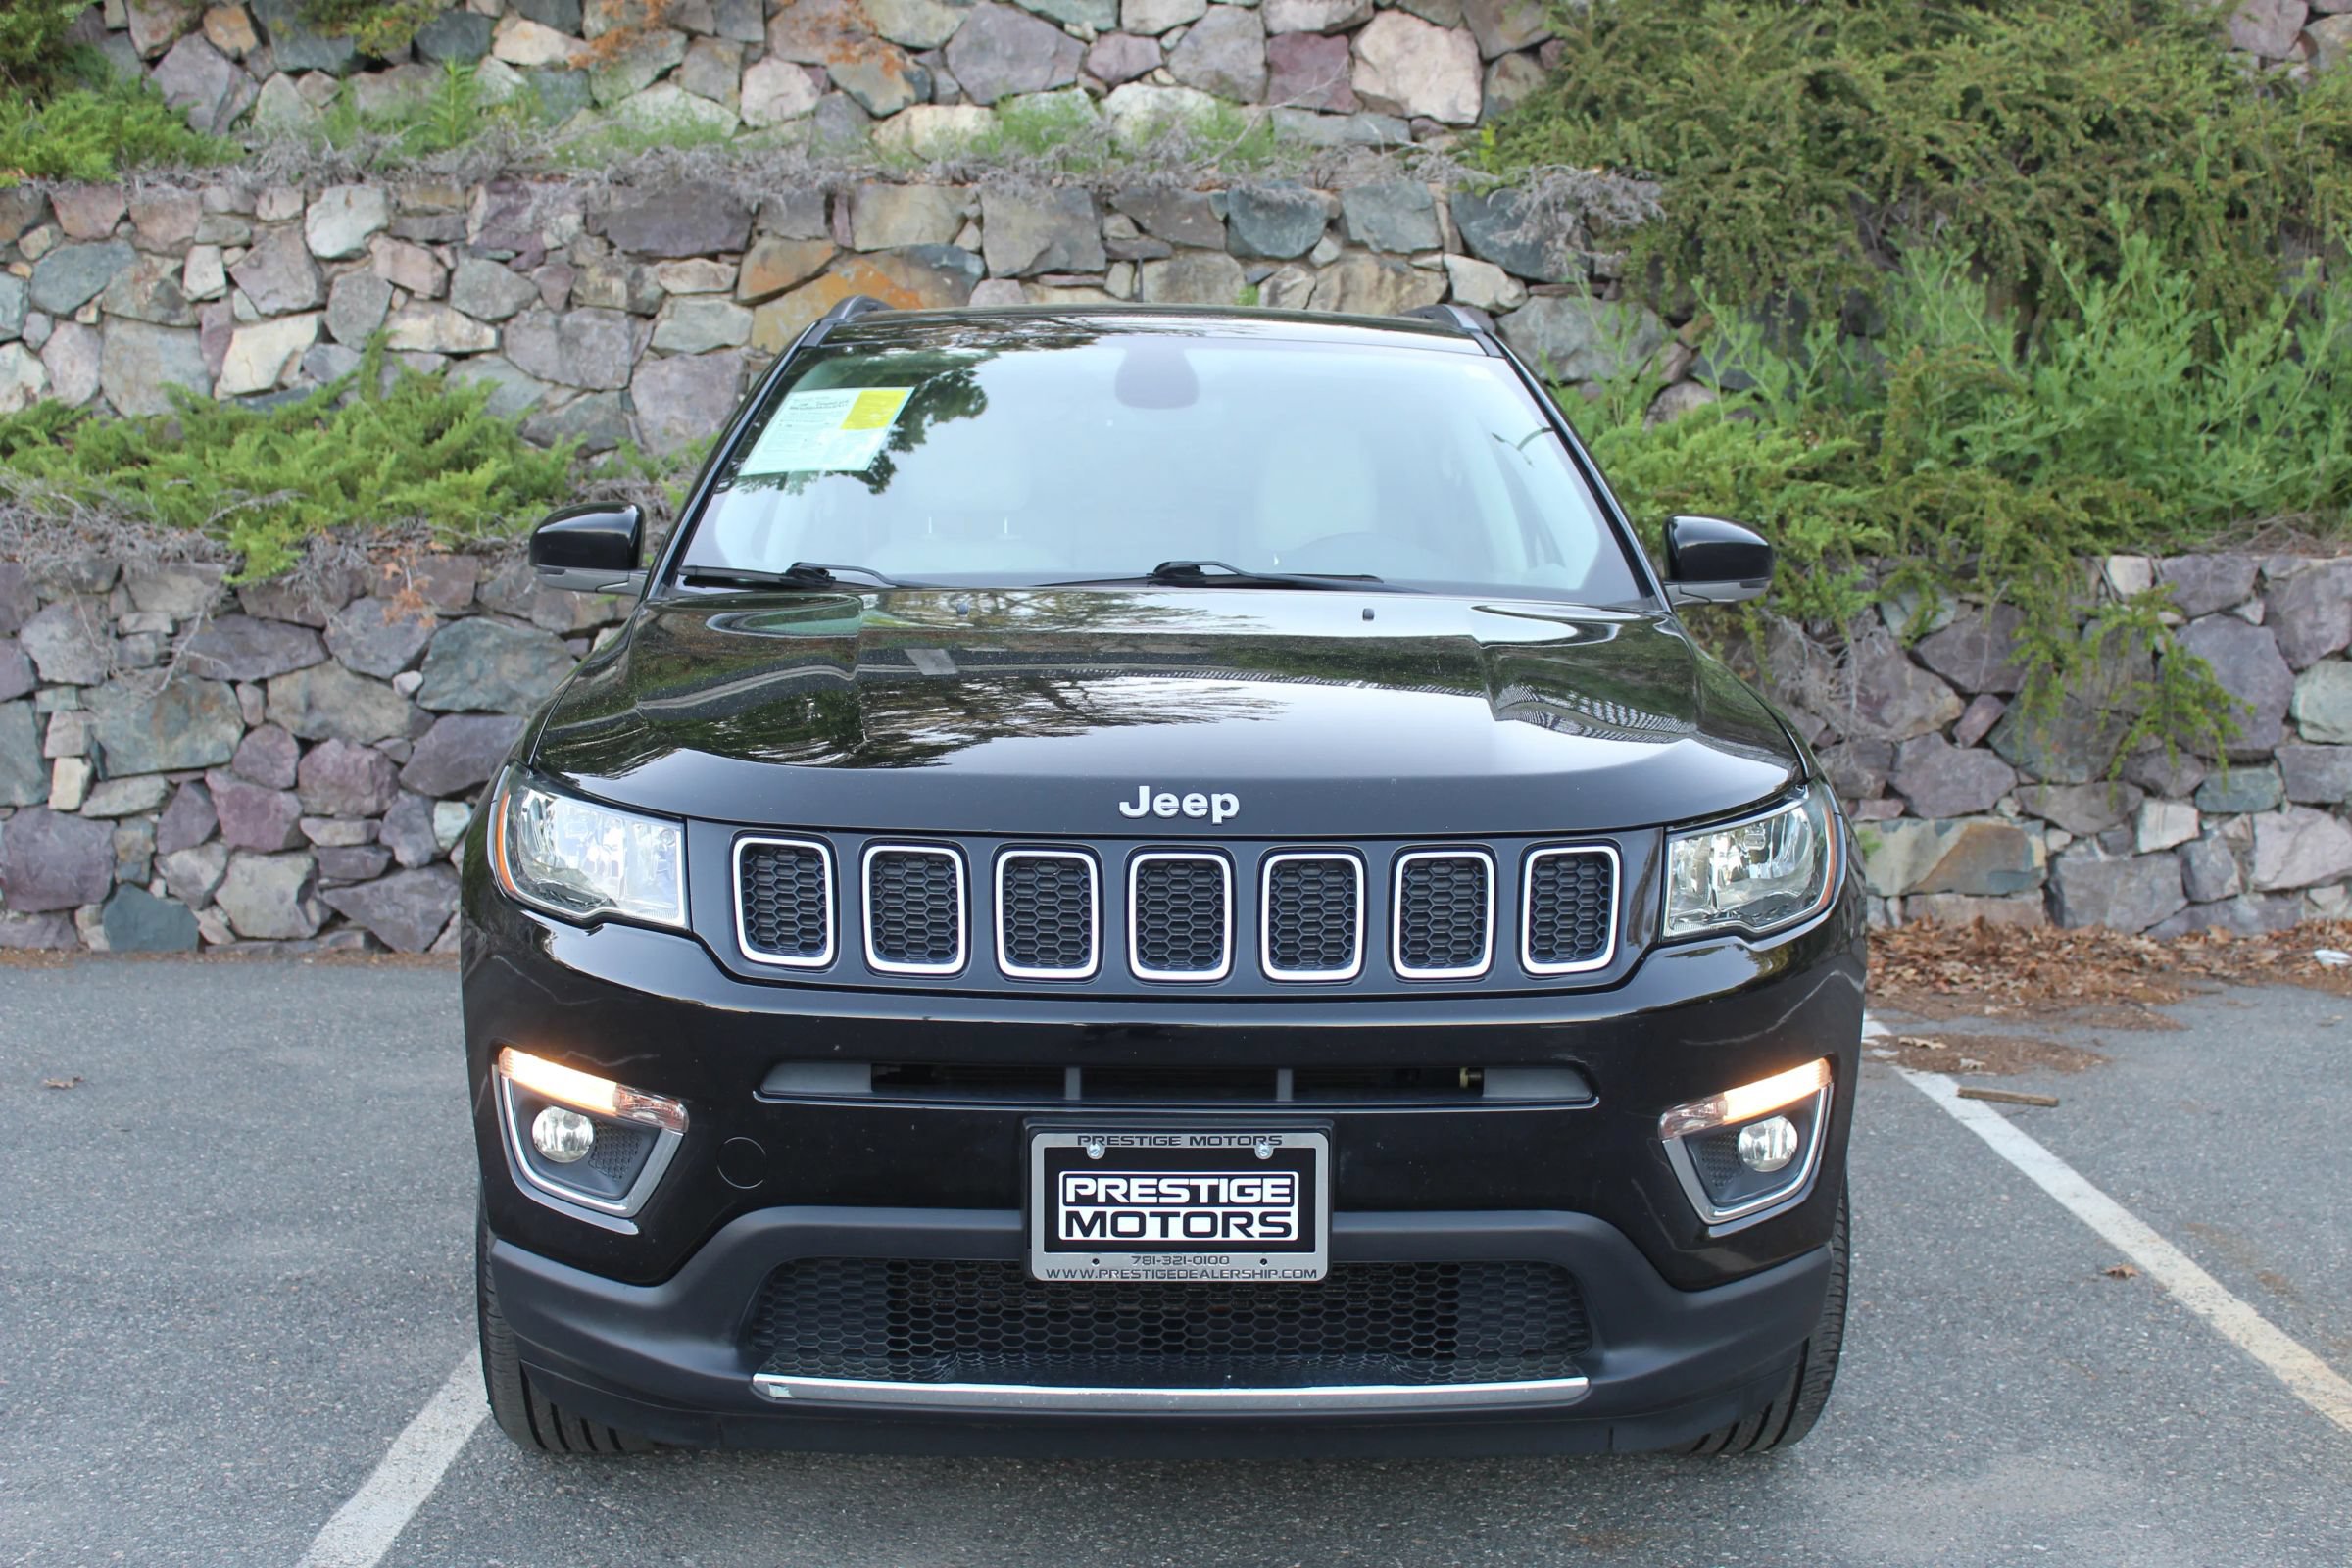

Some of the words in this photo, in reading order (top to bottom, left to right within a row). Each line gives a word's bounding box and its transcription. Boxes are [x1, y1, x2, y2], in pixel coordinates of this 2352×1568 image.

[1118, 785, 1240, 826] Jeep
[1078, 1135, 1182, 1146] PRESTIGE
[1189, 1135, 1283, 1146] MOTORS
[1066, 1178, 1291, 1203] PRESTIGE
[1065, 1210, 1292, 1239] MOTORS
[1130, 1255, 1230, 1266] 781-321-0100
[1046, 1268, 1317, 1279] WWW.PRESTIGEDEALERSHIP.COM
